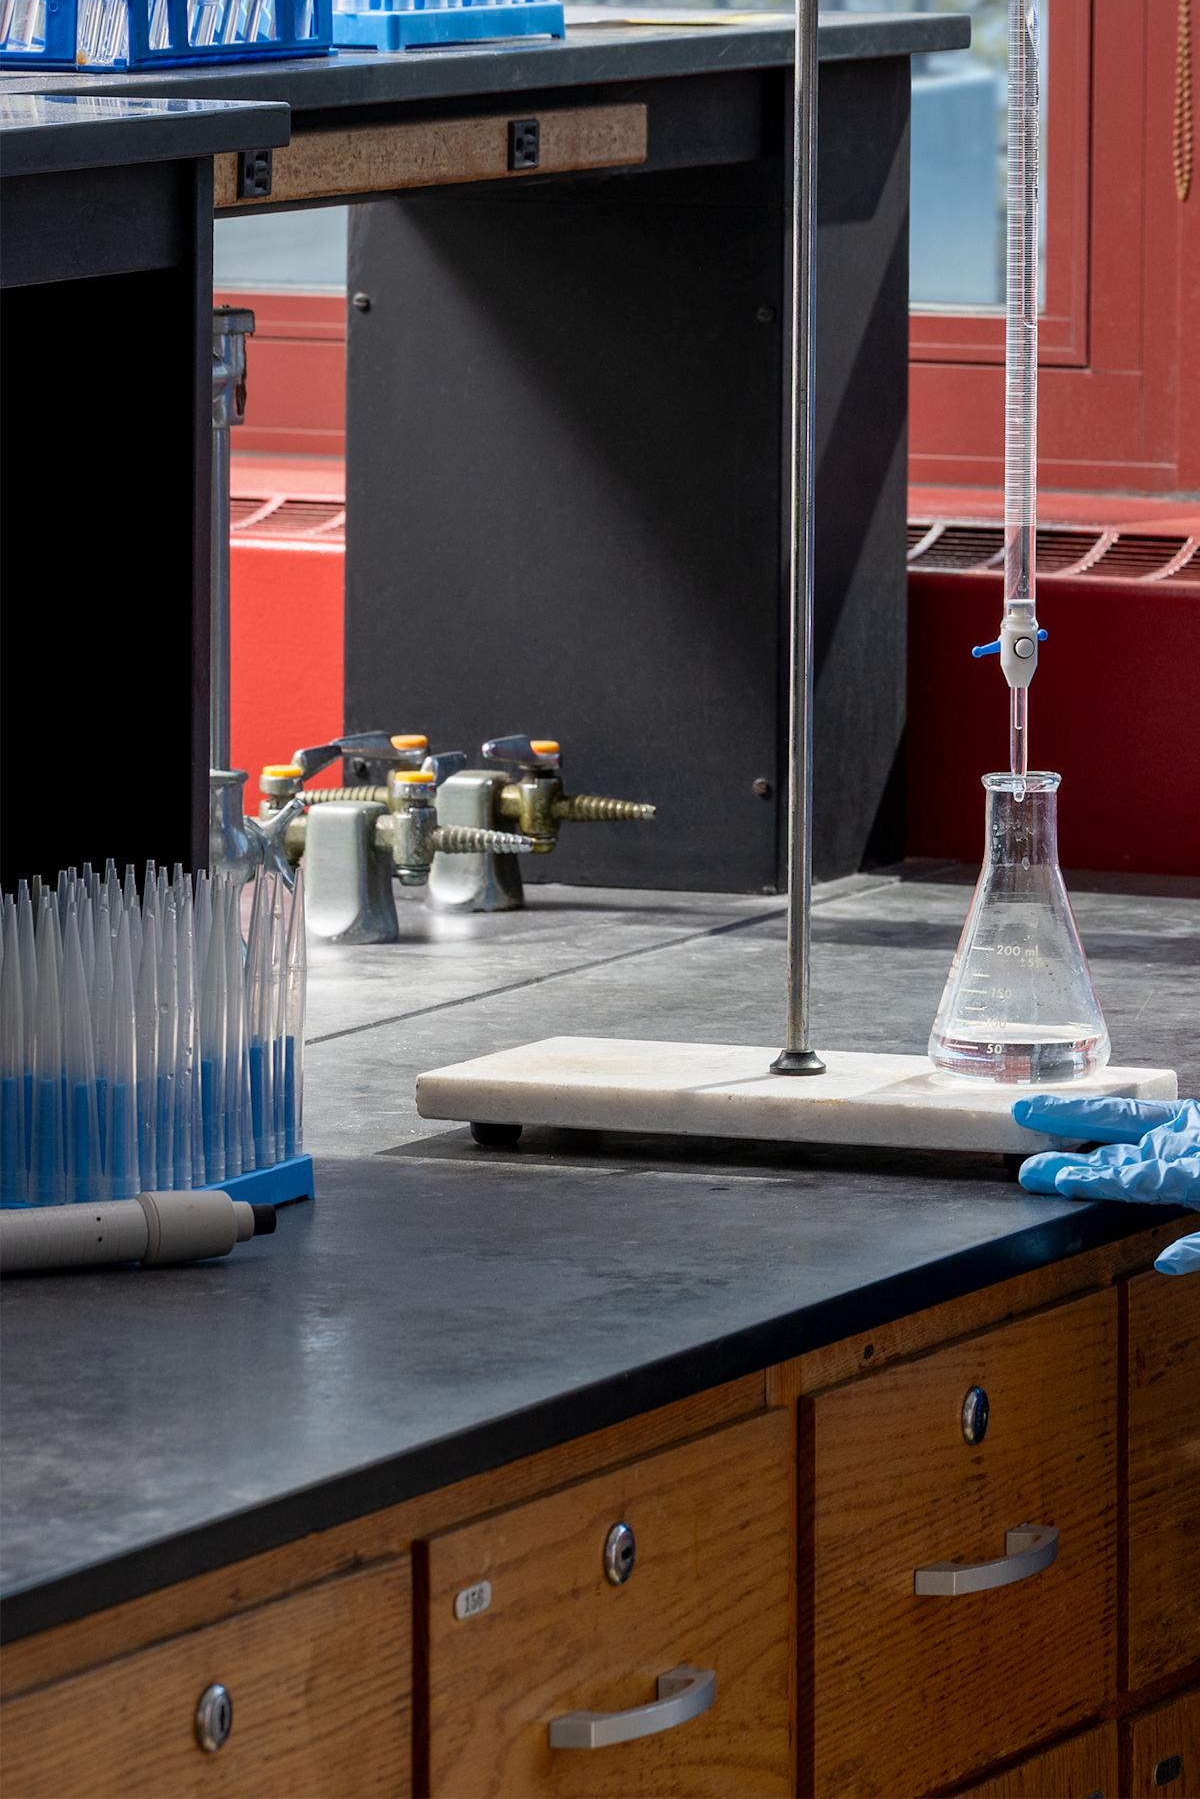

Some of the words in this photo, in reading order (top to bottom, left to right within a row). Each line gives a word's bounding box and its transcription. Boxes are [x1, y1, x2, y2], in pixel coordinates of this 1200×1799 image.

[996, 944, 1021, 956] 200
[991, 987, 1012, 999] 150
[986, 1043, 1003, 1055] 50
